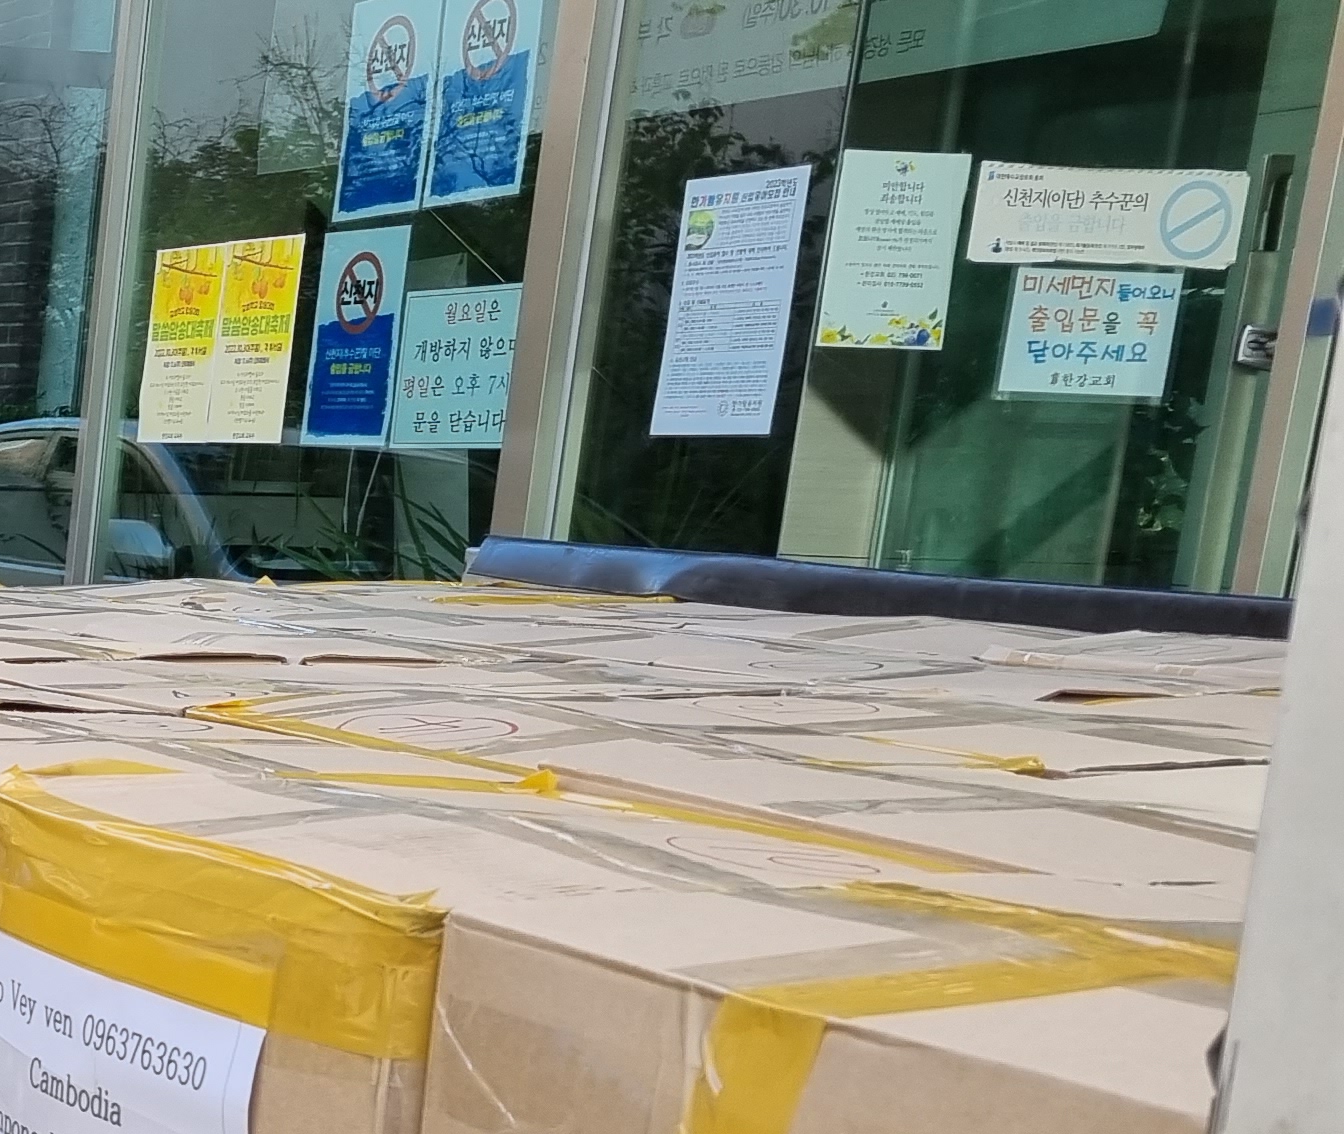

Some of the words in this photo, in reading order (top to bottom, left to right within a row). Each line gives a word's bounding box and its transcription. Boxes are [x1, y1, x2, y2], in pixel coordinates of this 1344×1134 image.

[468, 16, 511, 50] 신천지
[372, 40, 410, 74] 신천지
[1003, 187, 1086, 211] 신천지(이단)
[1089, 190, 1150, 213] 추수꾼의
[340, 275, 381, 308] 신천지
[1022, 274, 1117, 300] 미세먼지
[1117, 282, 1176, 303] 들어오니
[445, 299, 502, 325] 월요일은
[1027, 304, 1122, 335] 출입문을
[1136, 311, 1159, 336] 꼭
[414, 337, 471, 363] 개방하지
[1026, 339, 1149, 365] 닫아주세요
[402, 375, 445, 399] 평일은
[452, 373, 481, 397] 오후
[1063, 372, 1117, 388] 한강교회
[412, 411, 442, 434] 문을
[449, 408, 506, 434] 닫습니다
[9, 978, 36, 1027] Vey
[43, 1005, 73, 1041] ven
[82, 1012, 208, 1092] 0963763630
[28, 1056, 123, 1128] Cambodia
